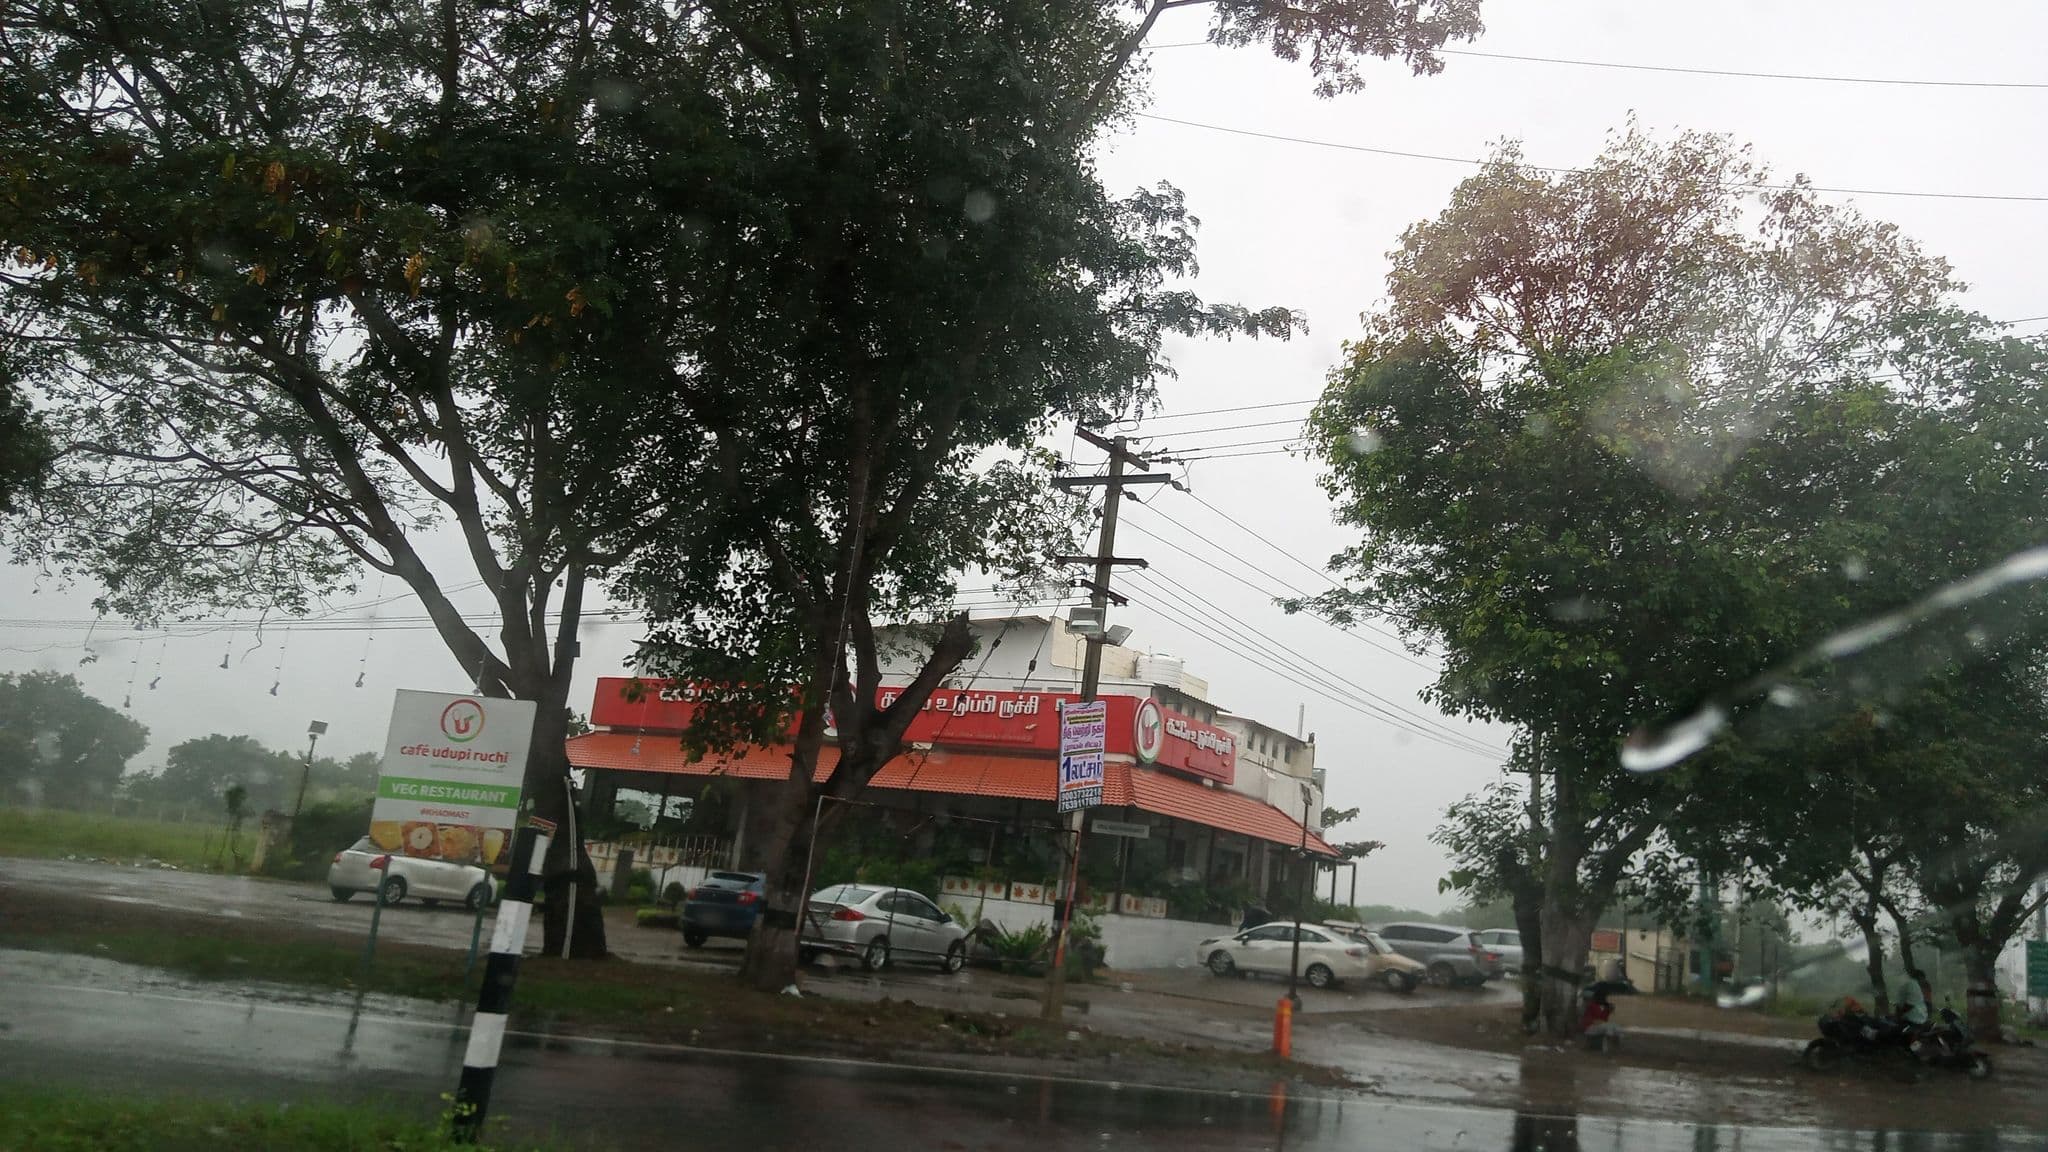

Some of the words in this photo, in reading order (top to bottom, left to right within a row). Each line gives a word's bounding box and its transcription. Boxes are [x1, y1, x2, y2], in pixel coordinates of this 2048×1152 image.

[999, 694, 1039, 718] ருச்சி
[400, 744, 429, 757] café
[432, 747, 471, 761] udupi
[474, 751, 508, 763] ruchi
[392, 783, 418, 796] VEG
[420, 784, 508, 804] RESTAURANT
